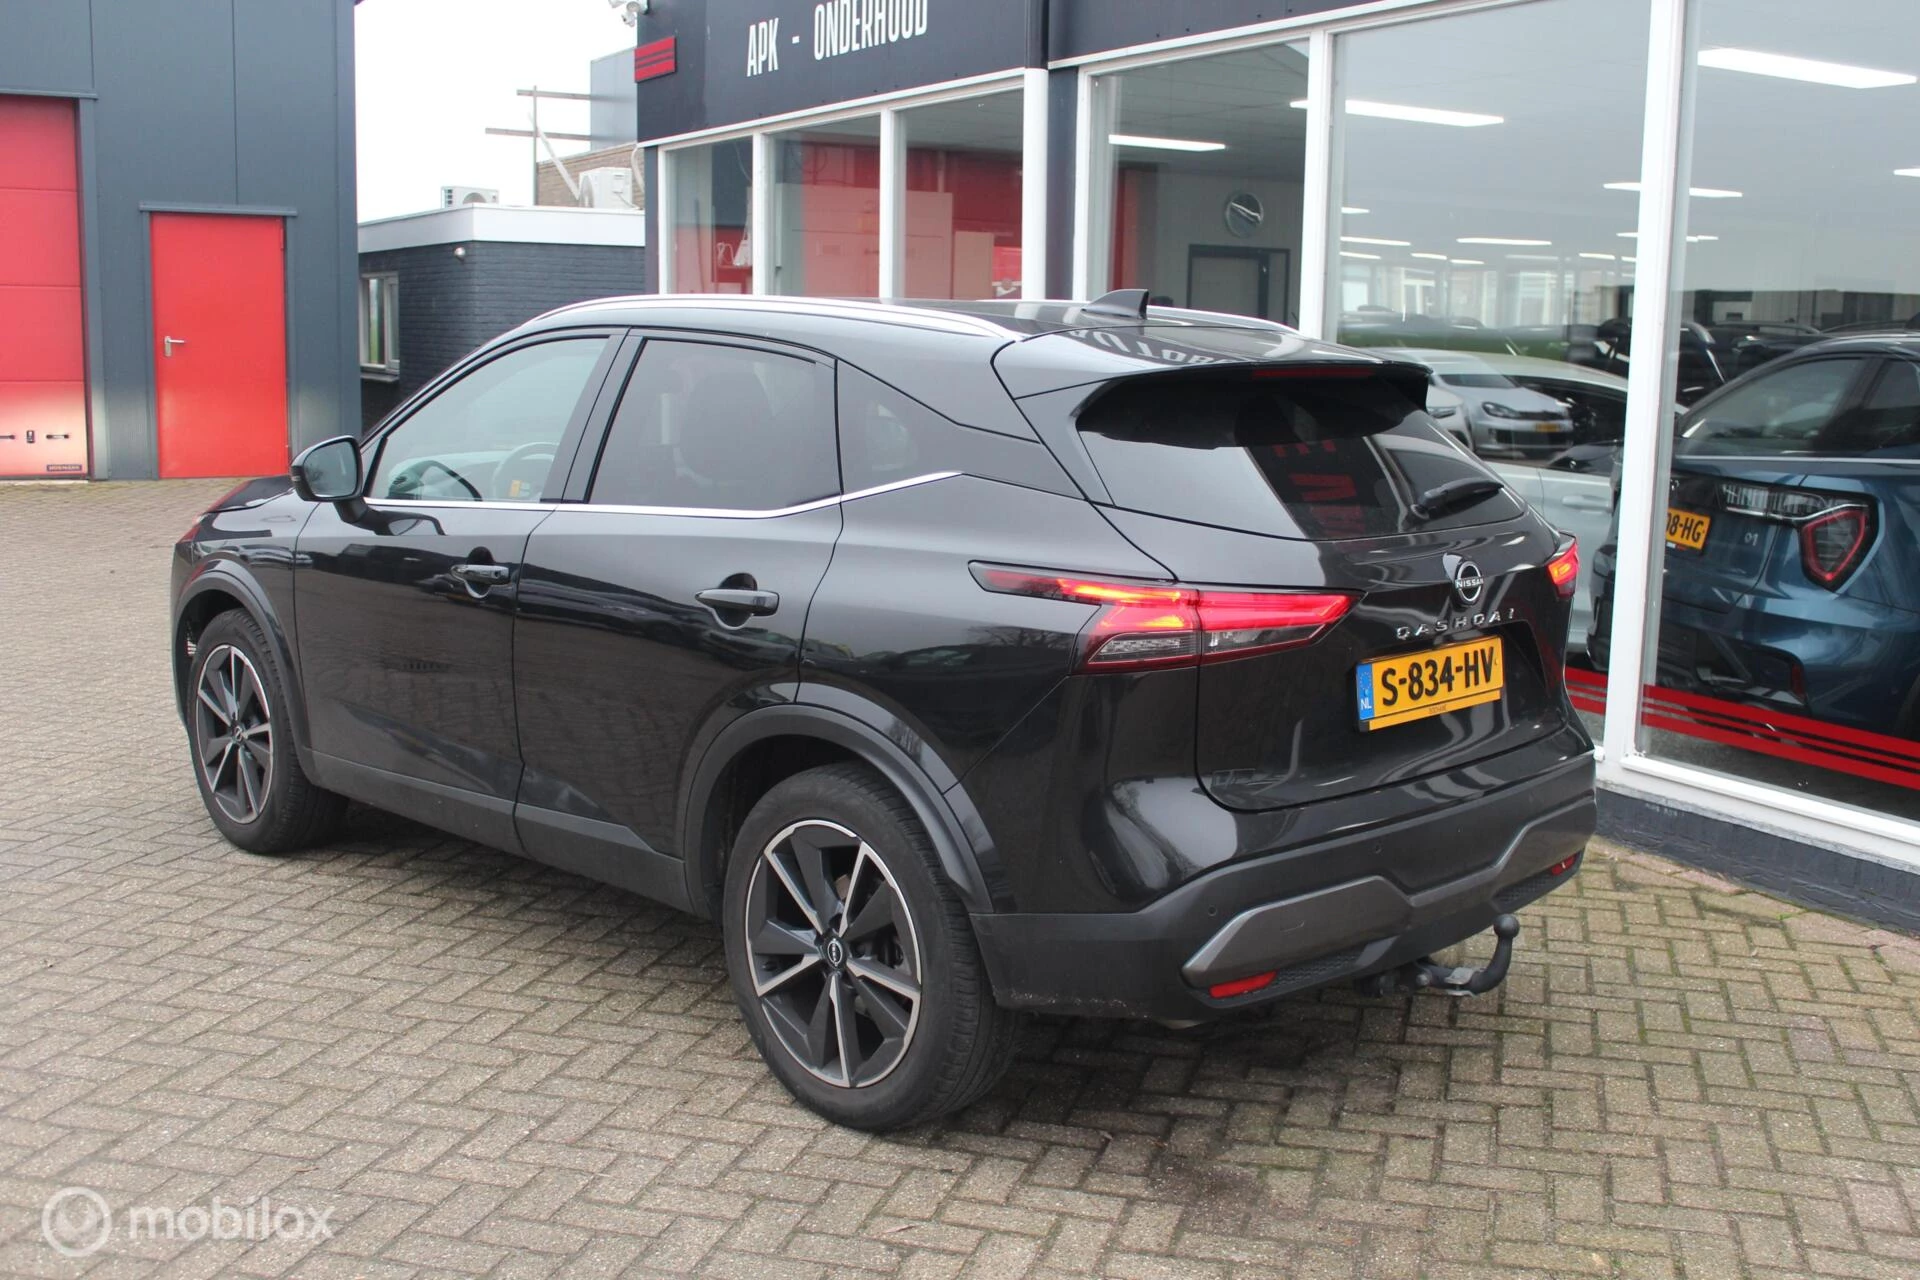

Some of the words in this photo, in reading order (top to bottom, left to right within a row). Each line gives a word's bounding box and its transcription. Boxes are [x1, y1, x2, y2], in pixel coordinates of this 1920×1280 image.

[747, 17, 779, 77] APK
[814, 0, 928, 61] ONDERHOUD
[1456, 578, 1484, 589] NISSAN
[1396, 608, 1515, 641] QASHQAI
[1360, 698, 1372, 710] NL
[1381, 646, 1494, 706] S-834-HV
